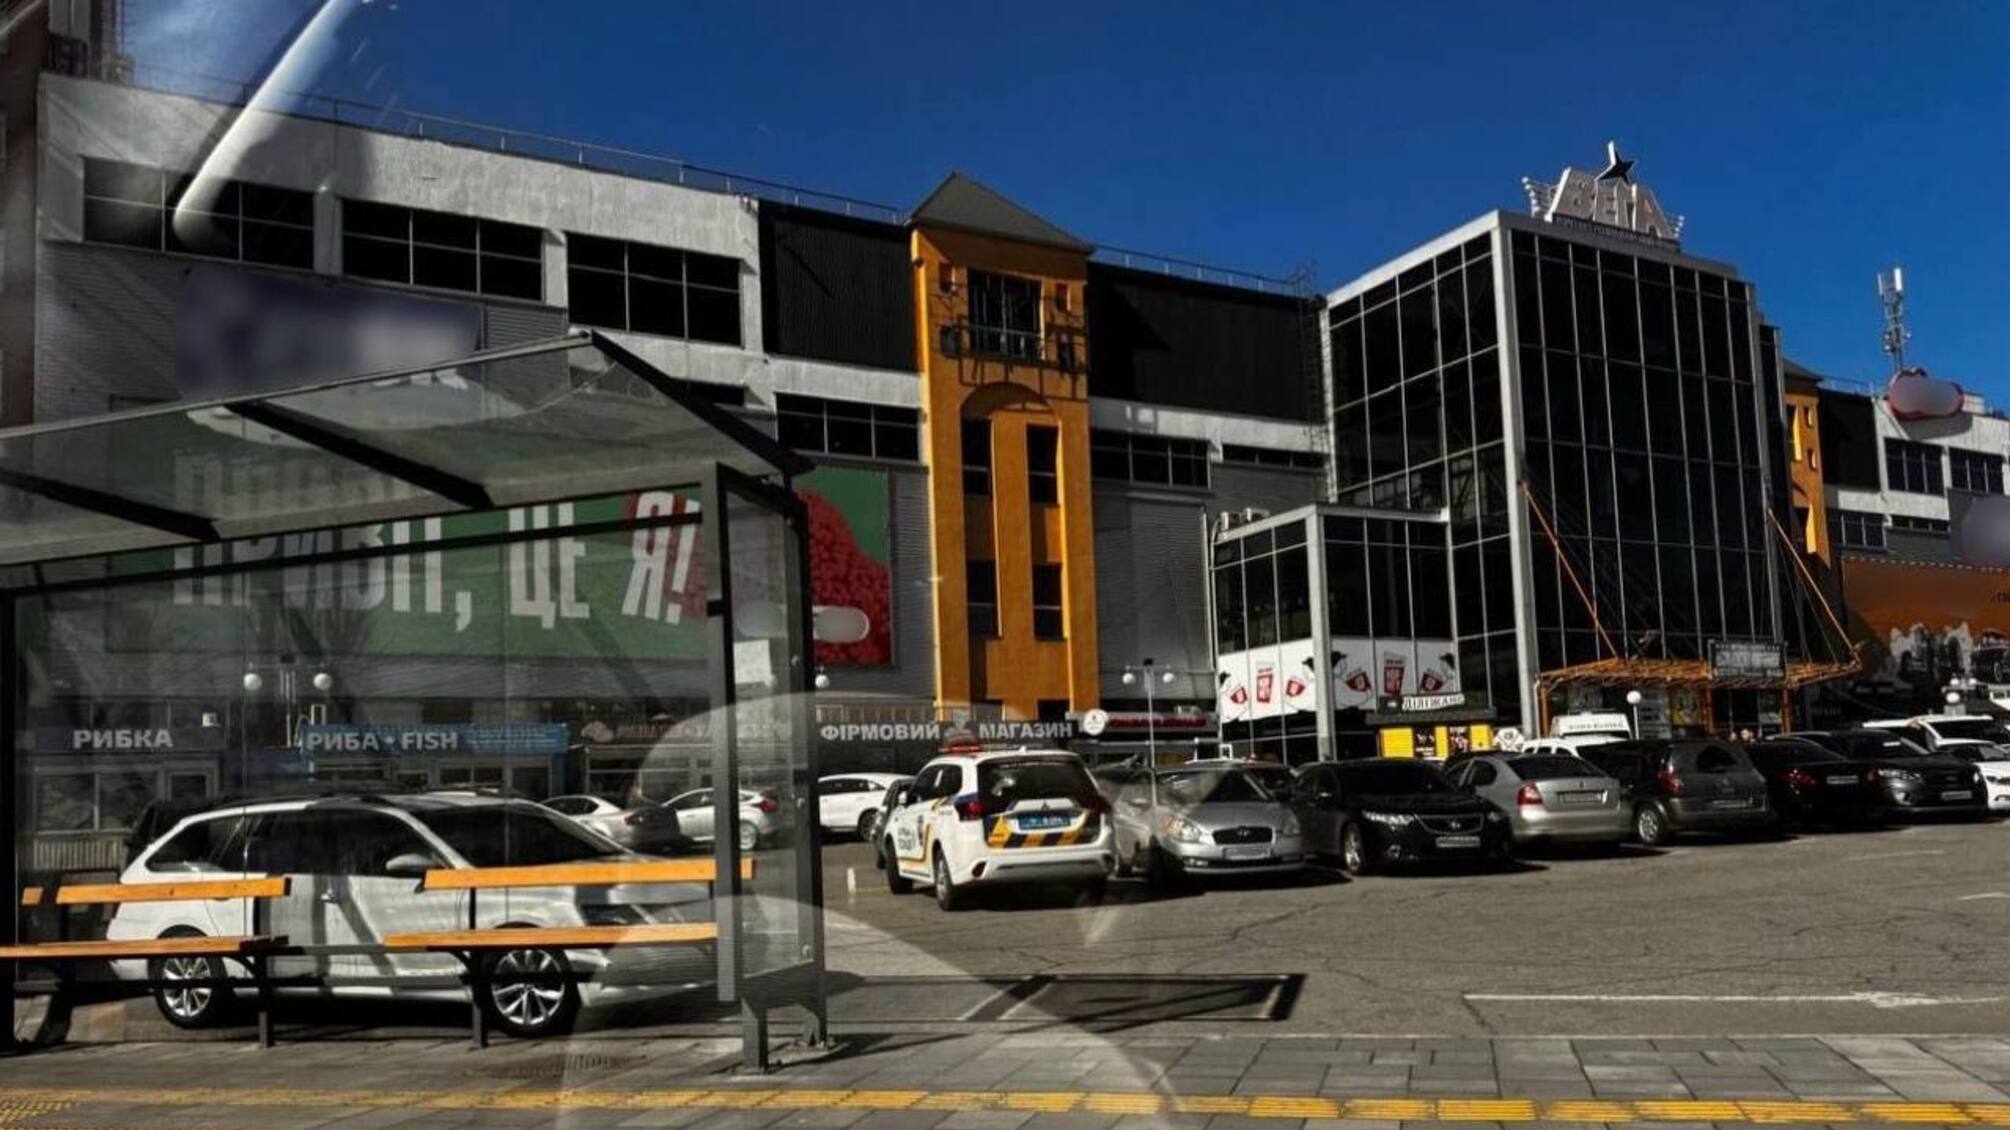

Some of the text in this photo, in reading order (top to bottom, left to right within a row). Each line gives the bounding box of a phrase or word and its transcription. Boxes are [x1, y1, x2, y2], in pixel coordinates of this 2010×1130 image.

[1544, 166, 1676, 241] ВЕГА
[508, 502, 590, 629] ЦЕ
[621, 490, 702, 625] Я!
[72, 729, 174, 749] РИБКА
[306, 731, 380, 751] РИБА
[400, 731, 459, 751] FISH
[820, 721, 941, 742] ФІРМОВИЙ
[978, 722, 1073, 740] МАГАЗИН
